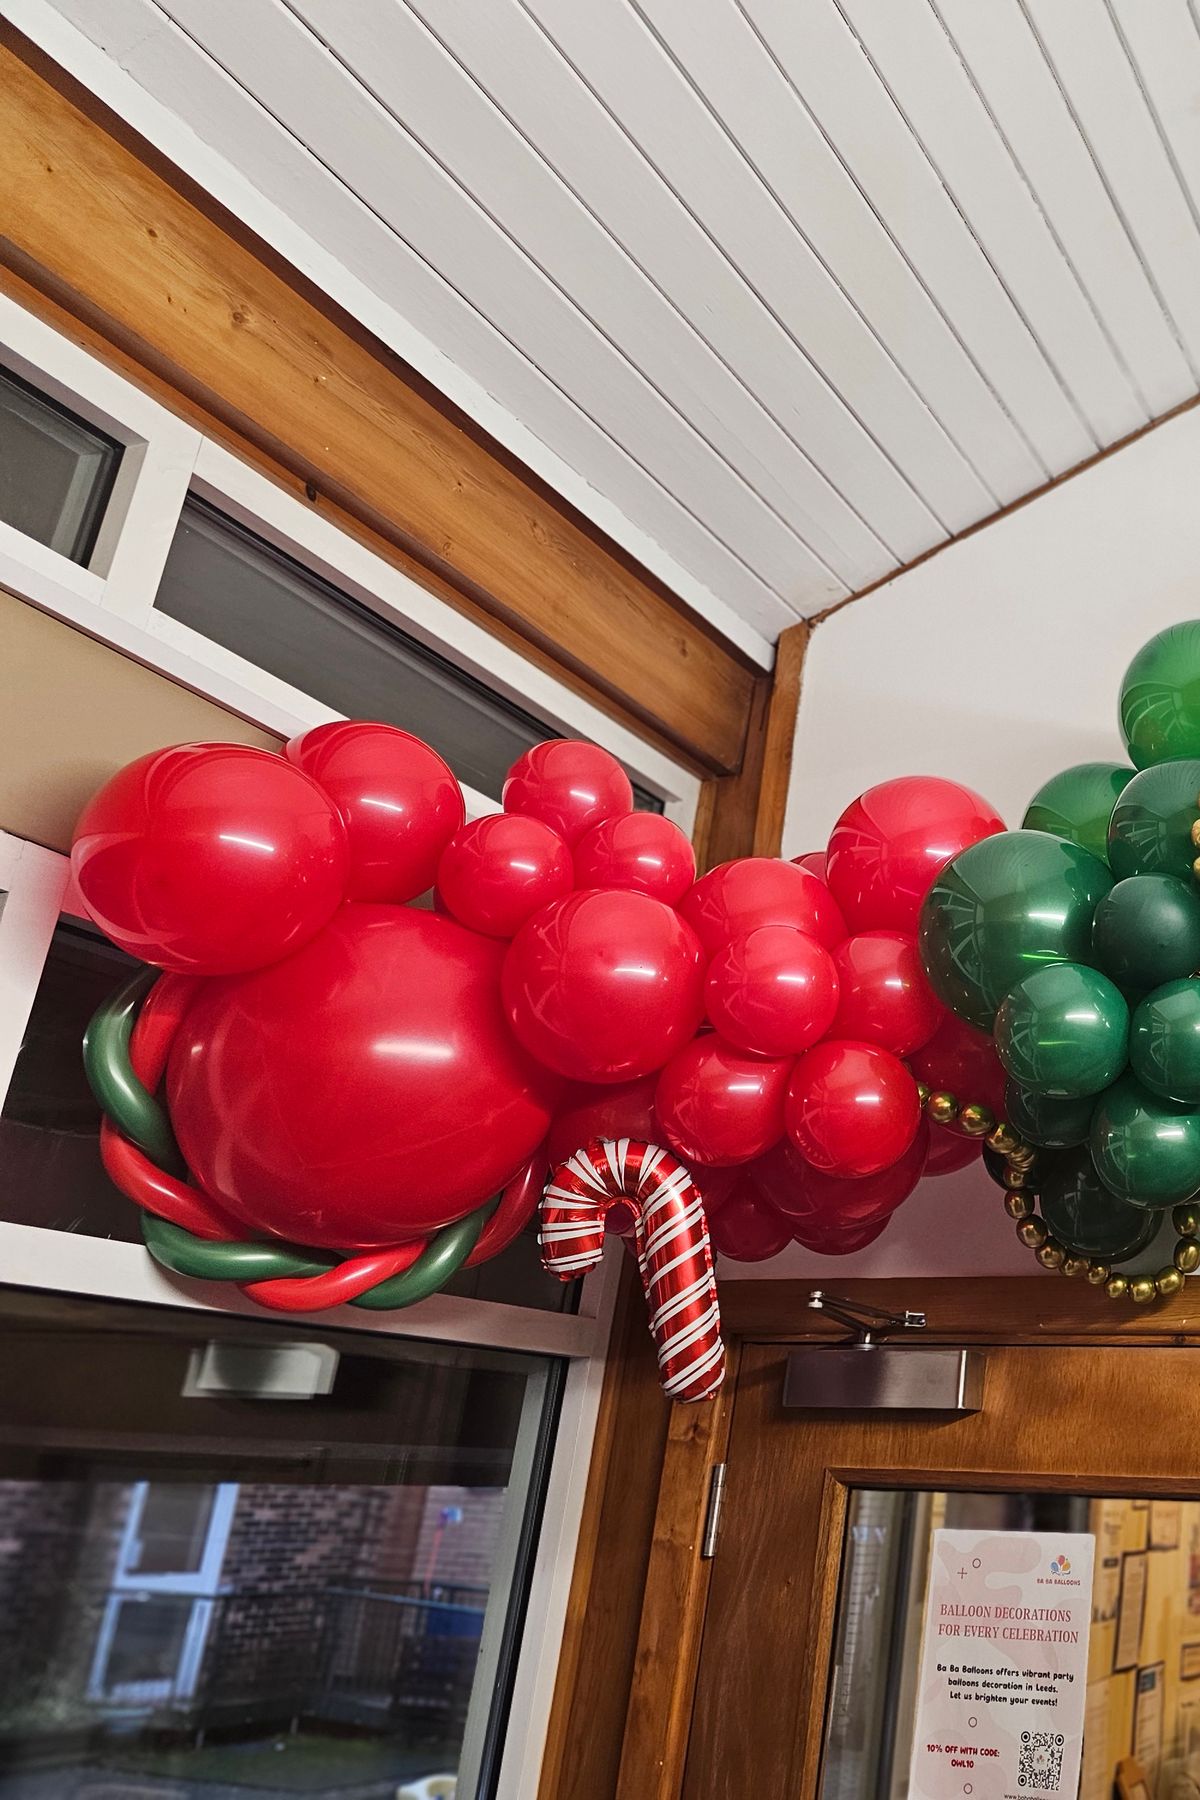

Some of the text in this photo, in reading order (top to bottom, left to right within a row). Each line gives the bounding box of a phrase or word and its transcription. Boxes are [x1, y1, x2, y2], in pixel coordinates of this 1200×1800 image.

[940, 1604, 1072, 1622] BALLOON DECORATIONS
[938, 1623, 1079, 1643] FOR EVERY CELEBRATION
[936, 1663, 1074, 1683] Ba Ba Balloons offers vibrant party
[947, 1677, 1059, 1693] balloons decoration in Leeds.
[949, 1691, 961, 1700] Let
[974, 1692, 1008, 1704] brighten
[1009, 1696, 1029, 1706] your
[1031, 1697, 1058, 1707] events!
[927, 1744, 1000, 1757] 10% OFF WITH CODE:
[951, 1759, 974, 1768] OWL10
